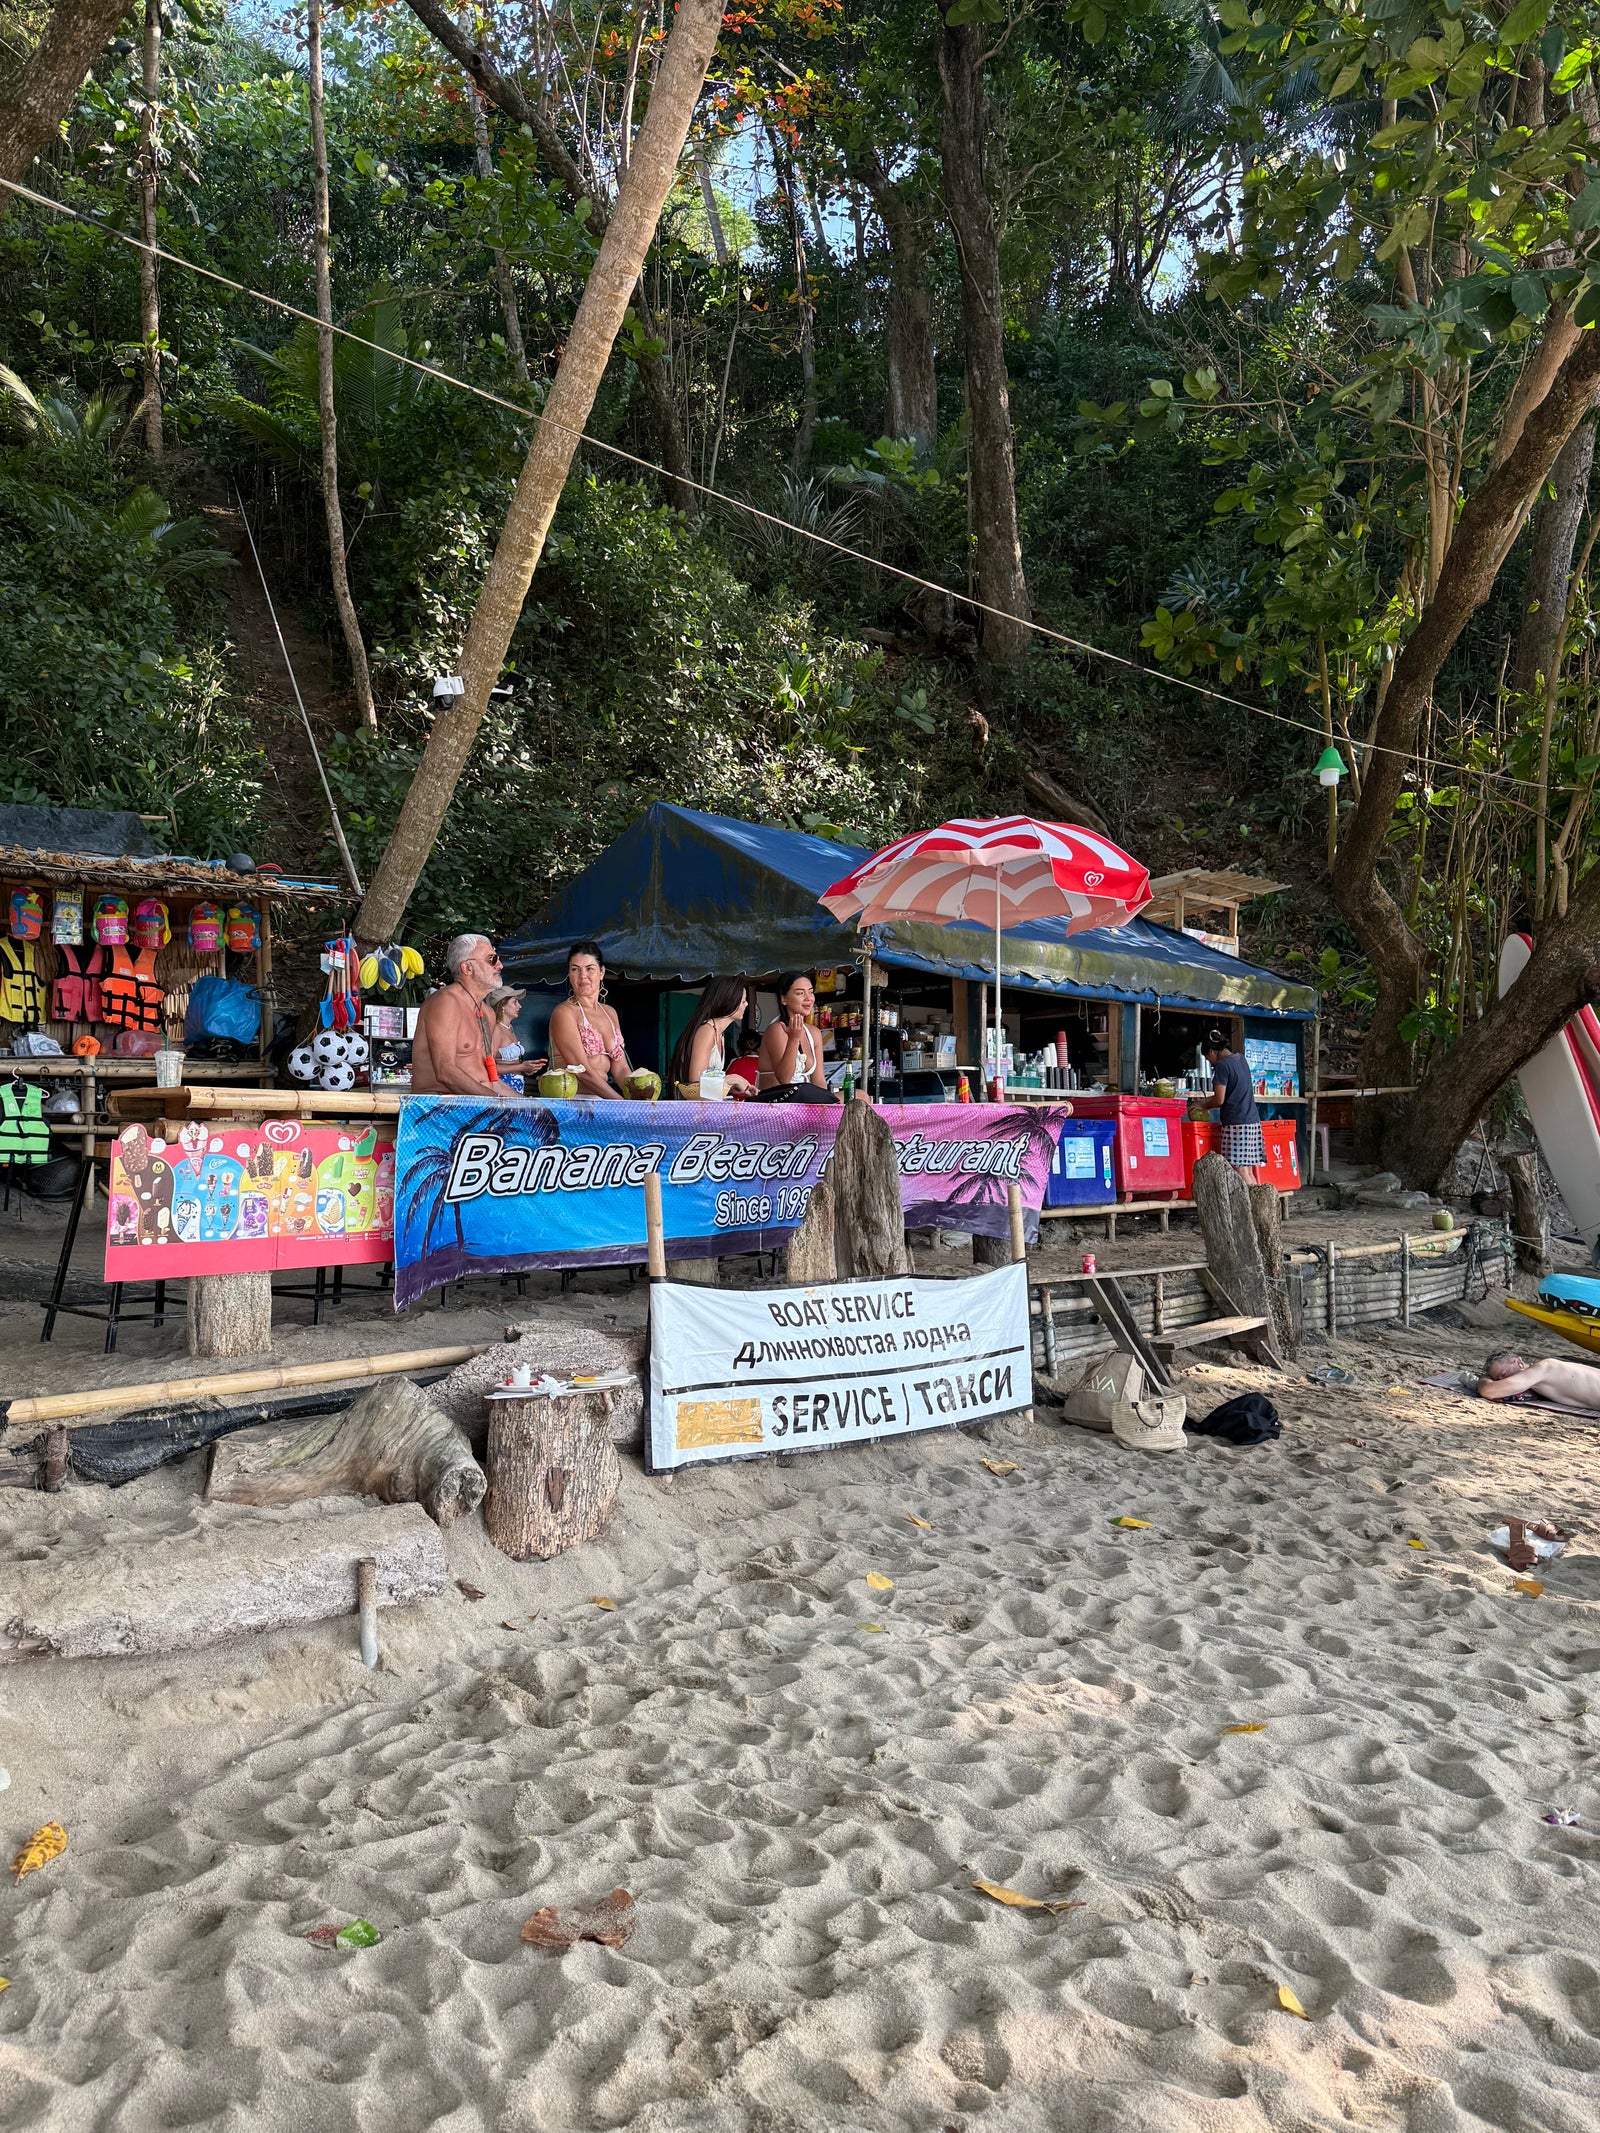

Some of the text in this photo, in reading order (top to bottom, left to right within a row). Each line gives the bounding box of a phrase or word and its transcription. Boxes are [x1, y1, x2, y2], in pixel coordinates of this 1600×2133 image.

[445, 1133, 666, 1202] Banana
[669, 1132, 820, 1182] Beach
[816, 1132, 1030, 1178] taurant
[714, 1184, 814, 1227] Since 199
[768, 1291, 916, 1327] BOAT SERVICE
[903, 1322, 971, 1352] лодка
[771, 1385, 897, 1437] SERVICE
